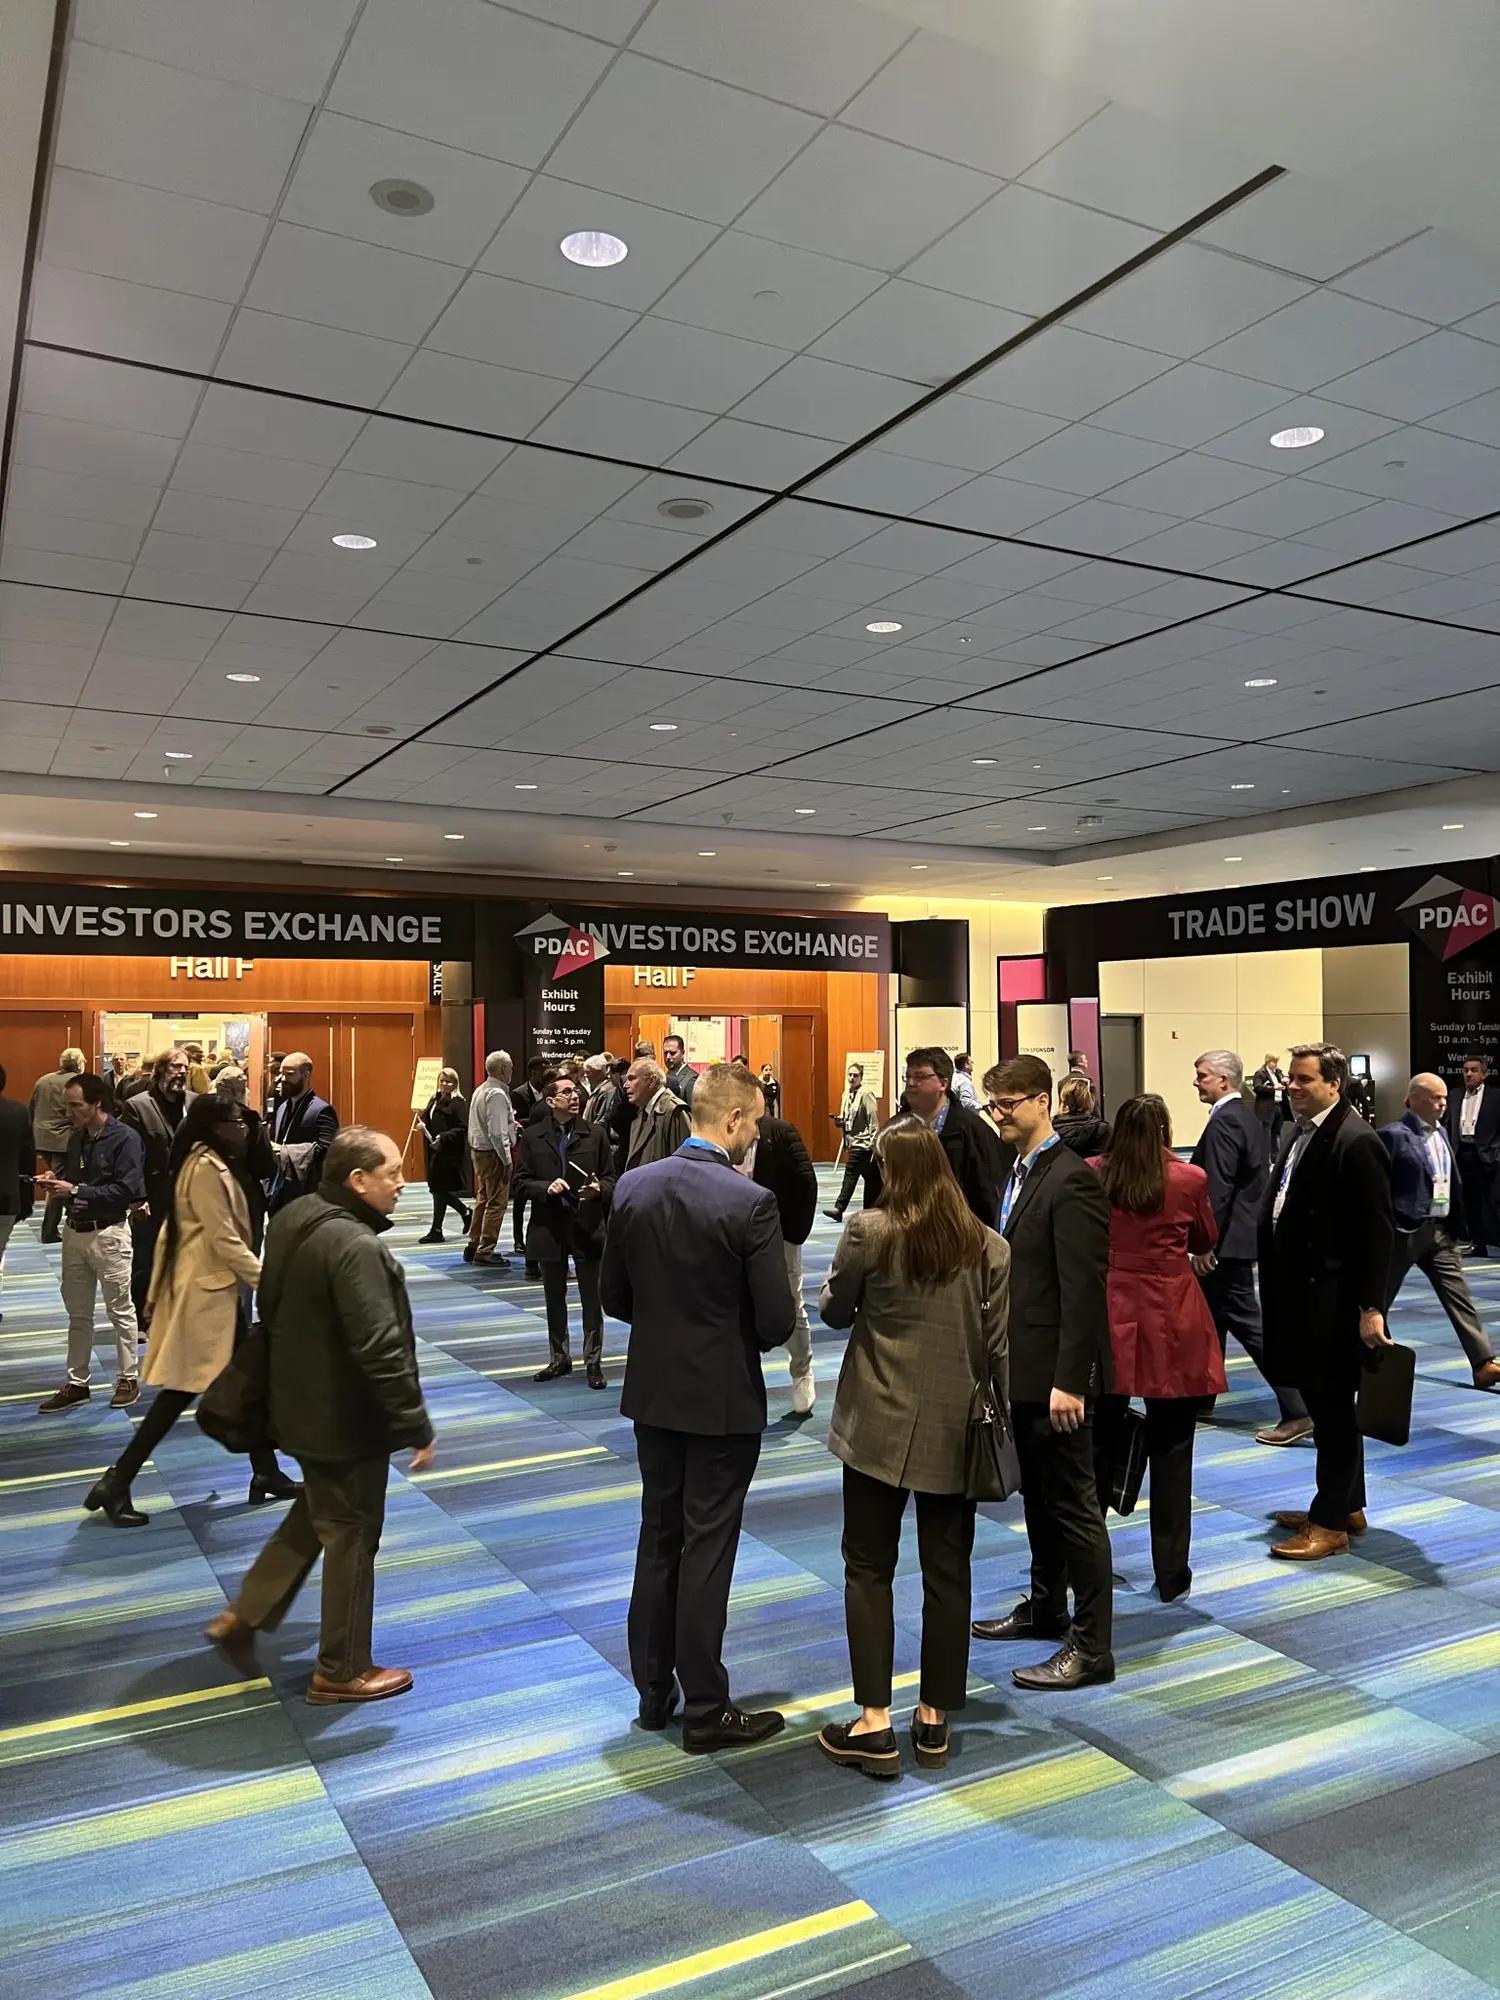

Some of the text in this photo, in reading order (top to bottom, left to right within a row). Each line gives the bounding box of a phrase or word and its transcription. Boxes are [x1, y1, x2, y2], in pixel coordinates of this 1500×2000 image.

[2, 903, 442, 943] INVESTORS EXCHANGE
[1168, 892, 1376, 940] TRADE SHOW
[1419, 903, 1488, 930] PDAC
[534, 937, 590, 957] PDAC
[744, 930, 879, 958] EXCHANGE
[170, 956, 229, 979] Hall
[634, 966, 696, 988] Hall F
[1447, 971, 1493, 984] Exhibit
[433, 964, 442, 996] SALLE
[541, 989, 579, 999] Exhibit
[1451, 988, 1491, 1000] Hours
[543, 1001, 576, 1011] Hours
[1430, 1022, 1465, 1032] Sunday
[1467, 1023, 1476, 1031] to
[536, 1037, 544, 1045] 10
[564, 1037, 569, 1045] 5
[1438, 1035, 1450, 1044] 10
[1479, 1035, 1485, 1044] 5
